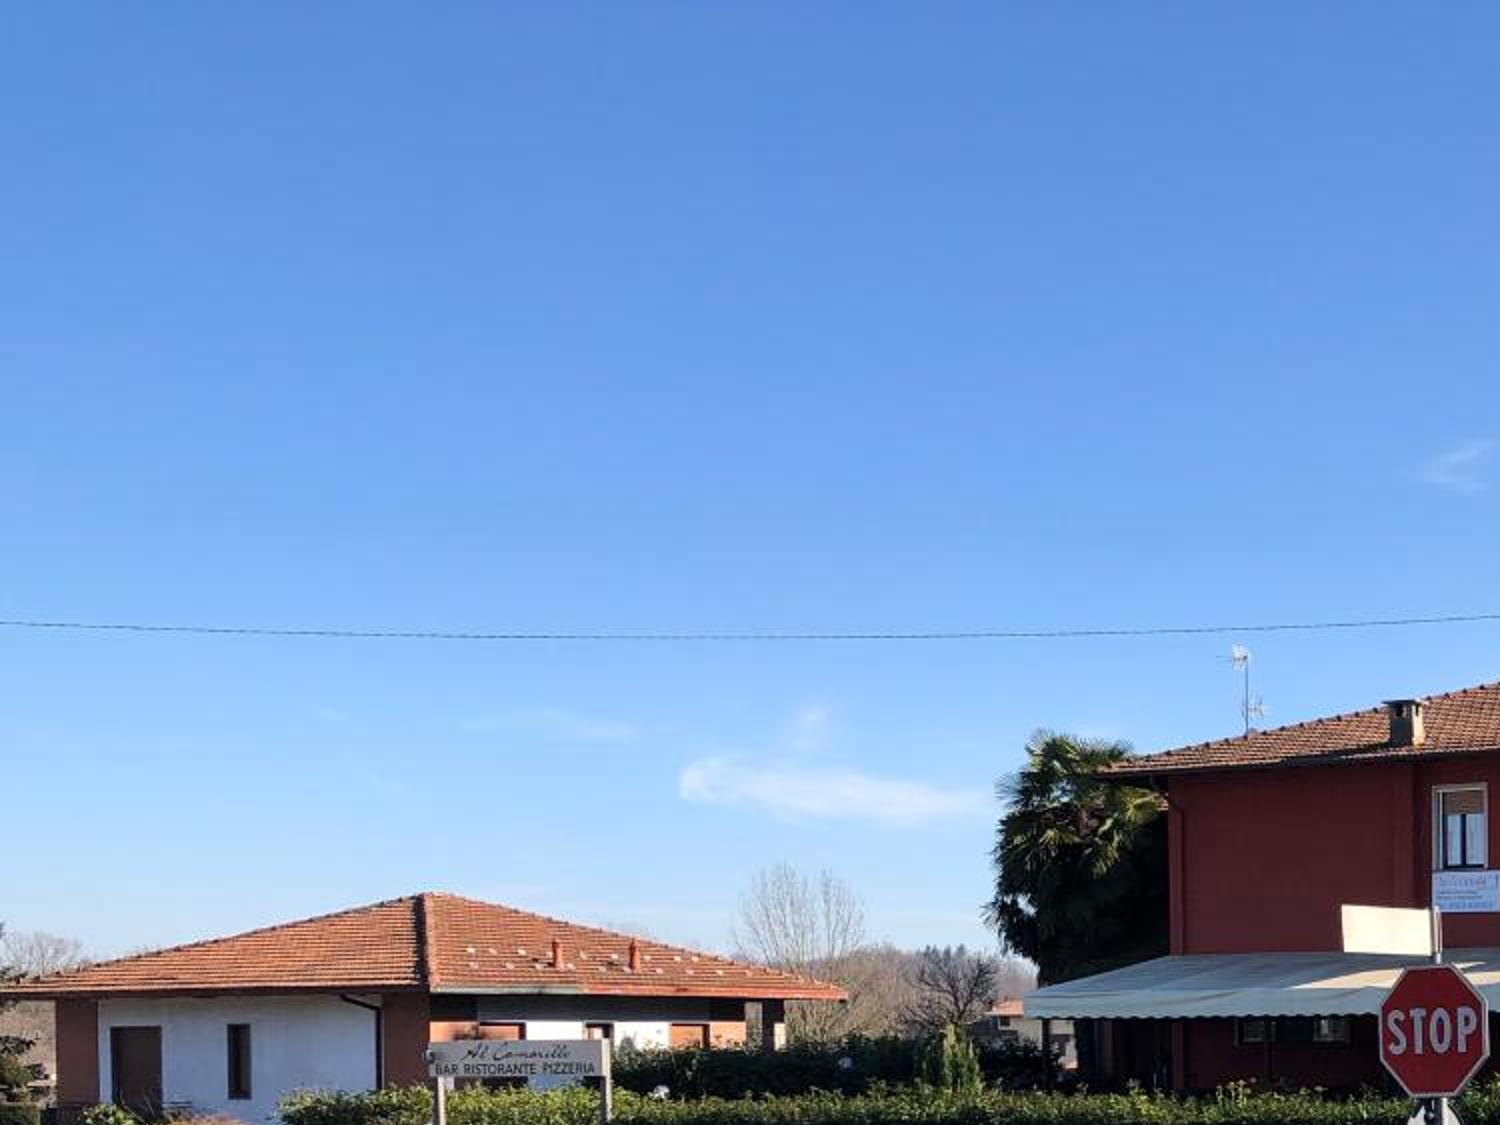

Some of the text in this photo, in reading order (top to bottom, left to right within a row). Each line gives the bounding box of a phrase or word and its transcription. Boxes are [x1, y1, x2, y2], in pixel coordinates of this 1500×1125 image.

[1387, 1006, 1477, 1055] STOP
[435, 1062, 595, 1076] BAR RISTORANTE PIZZERIA
